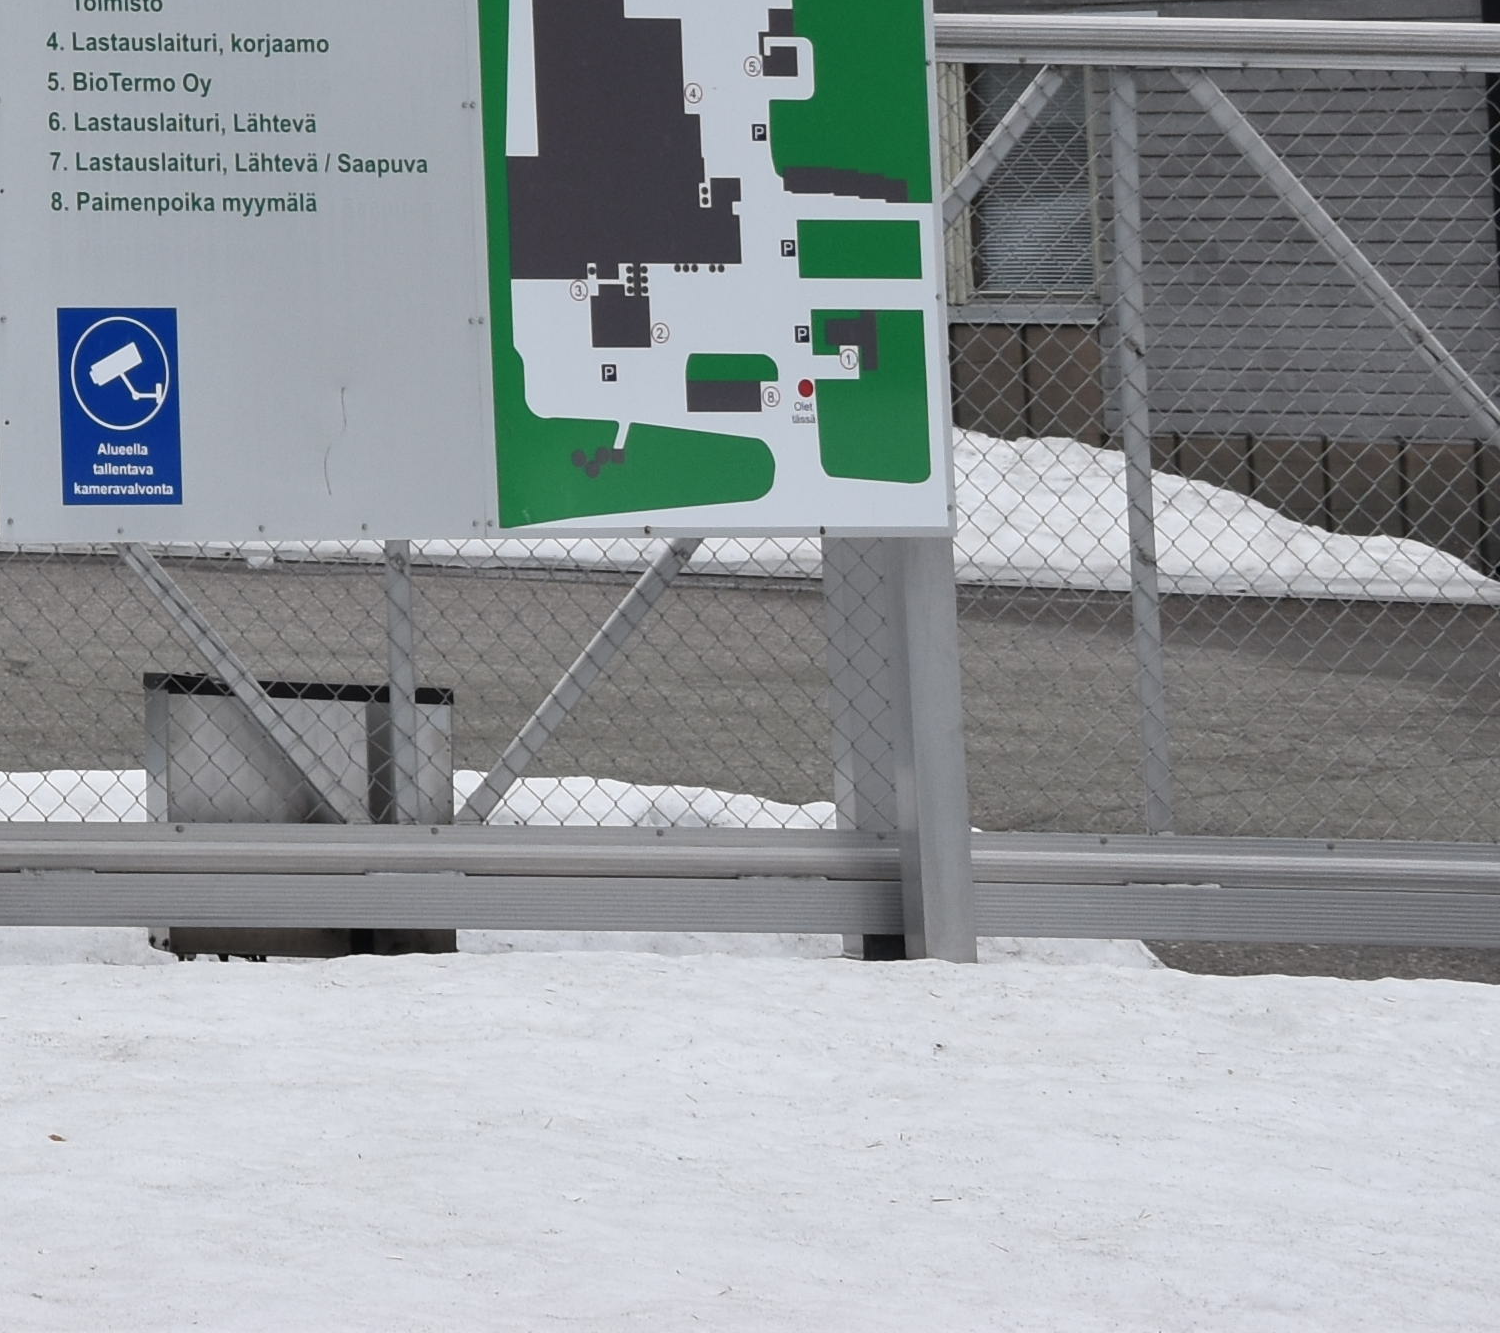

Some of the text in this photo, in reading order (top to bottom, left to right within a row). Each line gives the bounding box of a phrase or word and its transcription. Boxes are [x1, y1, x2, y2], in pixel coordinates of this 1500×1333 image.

[46, 31, 330, 58] 4. Lastauslaituri, korjaamo
[47, 71, 212, 98] 5. BioTermo Oy
[48, 111, 317, 136] 6. Lastauslaituri, Lähtevä
[755, 126, 764, 139] P
[49, 151, 68, 171] 7.
[75, 151, 228, 176] Lastauslaituri,
[235, 152, 318, 173] Lähtevä
[337, 153, 428, 178] Saapuva
[50, 191, 317, 218] 8. Paimenpoika myymälä
[784, 242, 793, 255] P
[798, 328, 807, 341] P
[605, 367, 614, 380] P
[793, 401, 813, 412] Olet
[97, 442, 149, 456] Alueella
[92, 462, 154, 476] tallentava
[73, 481, 174, 495] kameravalvonta
